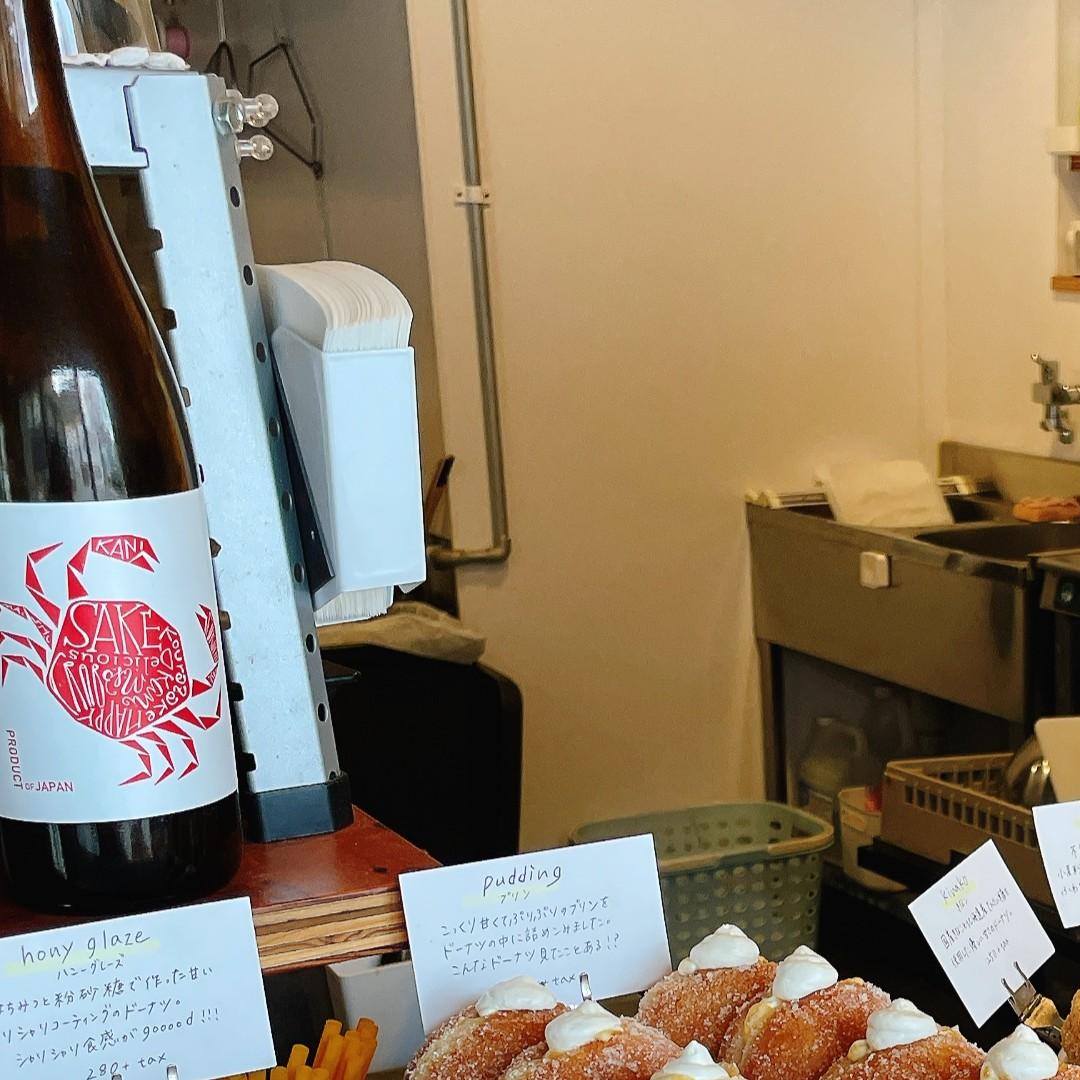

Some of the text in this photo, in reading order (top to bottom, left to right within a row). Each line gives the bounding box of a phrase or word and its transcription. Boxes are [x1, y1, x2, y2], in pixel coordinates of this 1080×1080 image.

[95, 538, 144, 560] KANI
[63, 601, 162, 656] SAKE
[6, 729, 74, 793] PRODUCT OF JAPAN
[482, 863, 563, 897] pudding
[87, 928, 152, 958] glaze
[551, 973, 577, 986] tax
[138, 1052, 167, 1069] tax
